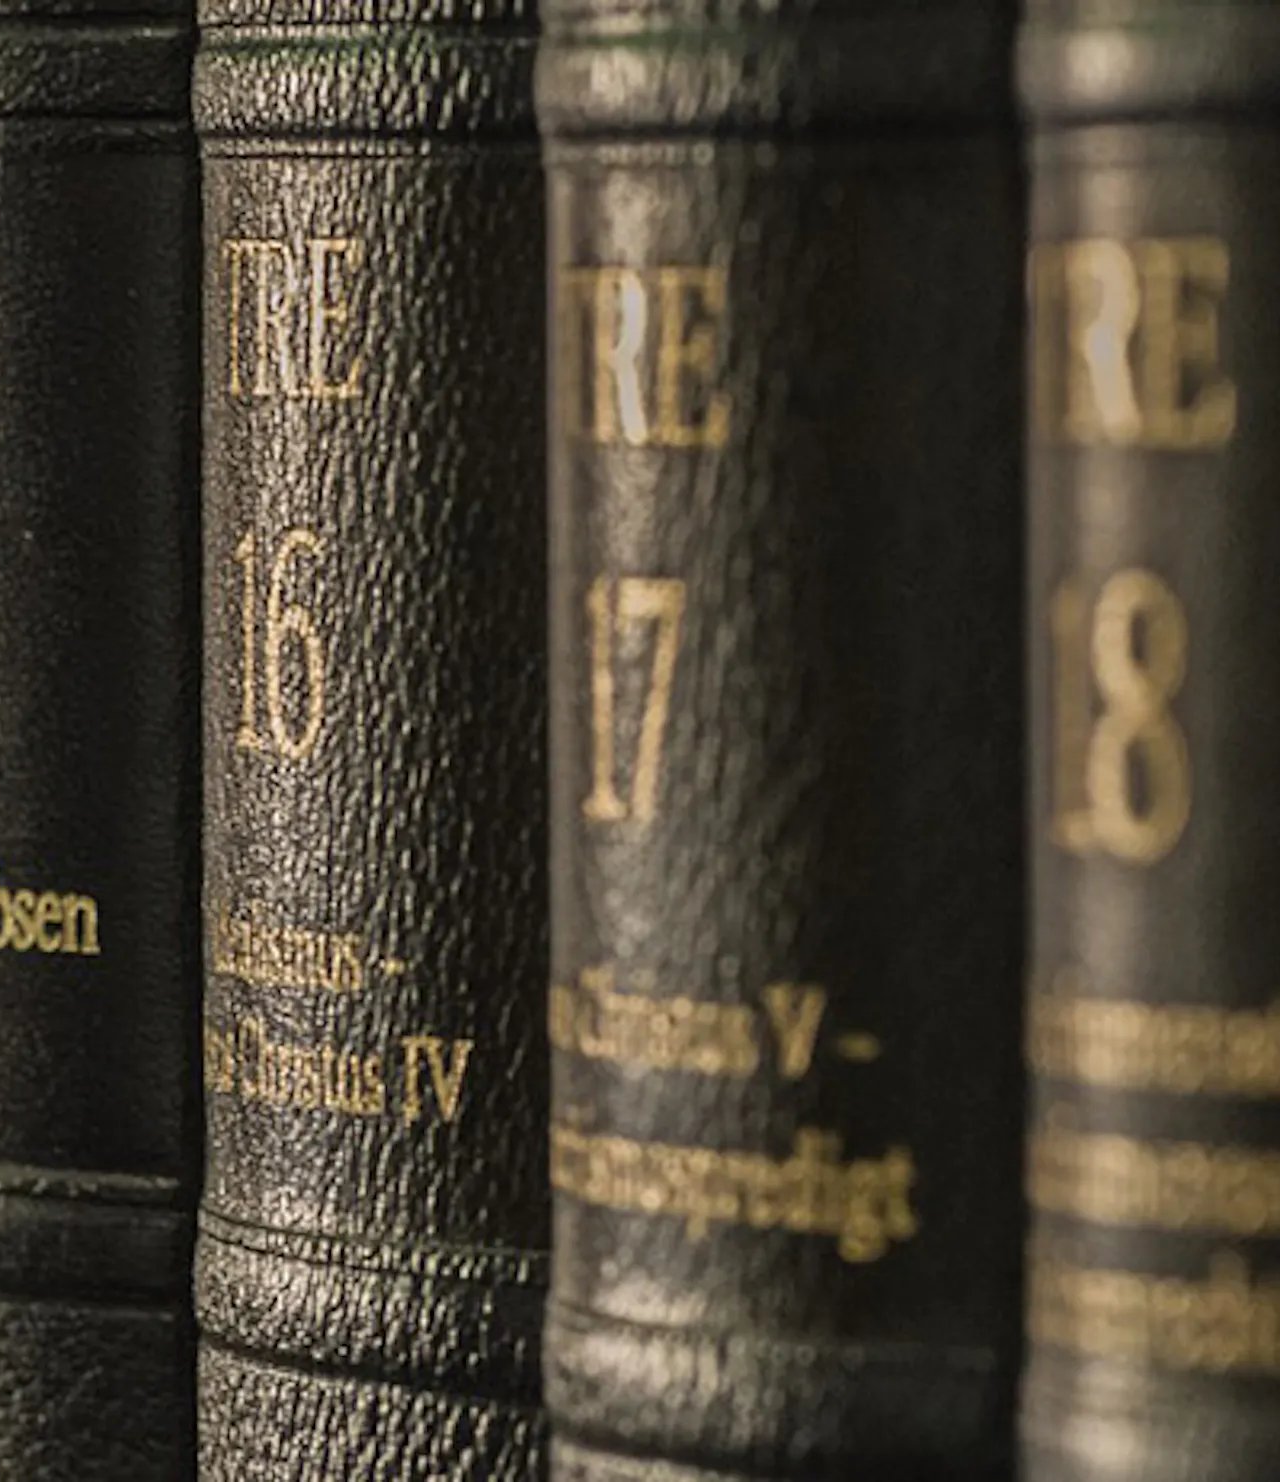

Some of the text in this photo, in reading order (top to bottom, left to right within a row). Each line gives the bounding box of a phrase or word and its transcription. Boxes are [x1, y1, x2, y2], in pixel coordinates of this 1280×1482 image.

[222, 237, 364, 400] TRE
[560, 266, 732, 447] TRE
[1028, 237, 1237, 449] TRE
[233, 529, 323, 758] 16
[584, 577, 687, 820] 17
[1050, 567, 1191, 866] 18
[402, 1036, 474, 1127] IV
[765, 982, 826, 1078] V
